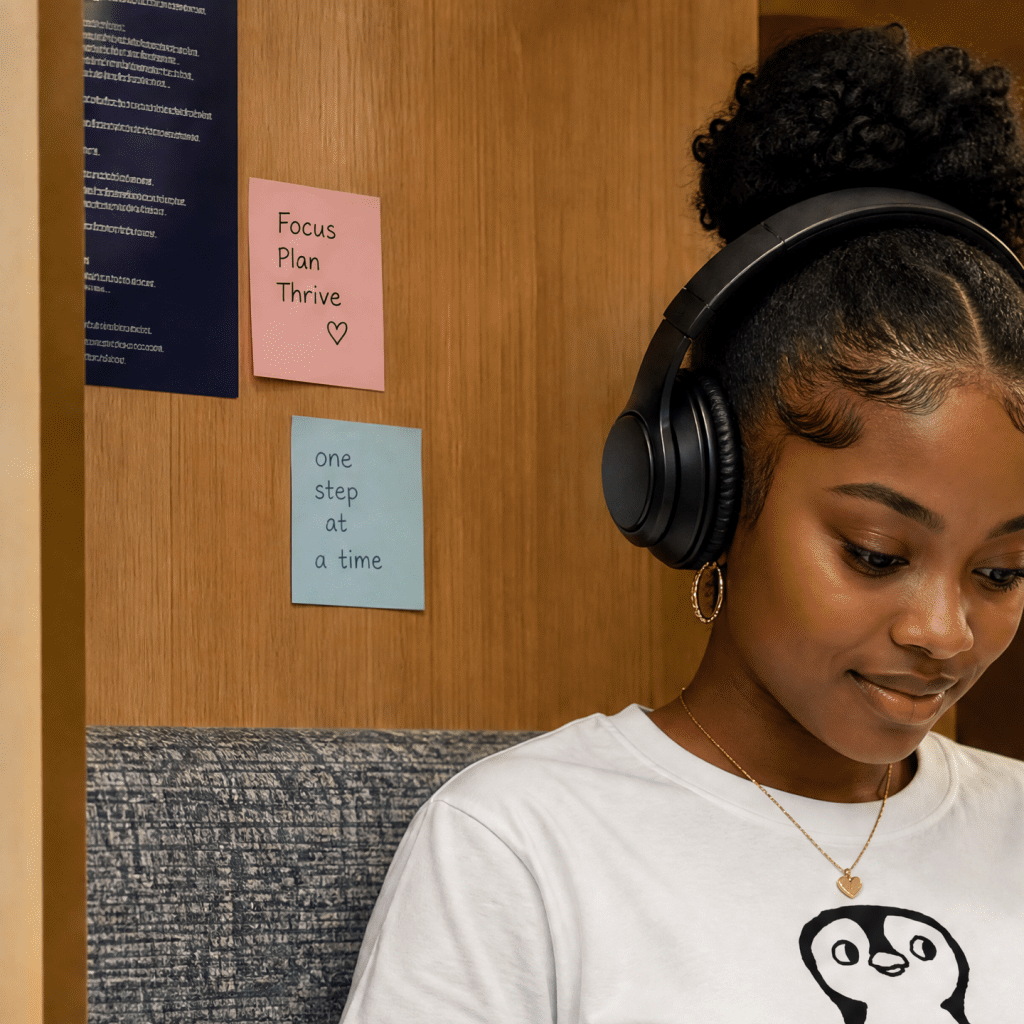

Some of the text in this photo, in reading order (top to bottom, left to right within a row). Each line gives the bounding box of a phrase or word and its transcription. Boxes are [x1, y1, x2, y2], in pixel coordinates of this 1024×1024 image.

[278, 212, 336, 240] Focus
[278, 246, 320, 271] Plan
[276, 281, 342, 307] Thrive
[314, 479, 358, 508] step
[325, 512, 348, 533] at
[314, 548, 383, 570] a time
